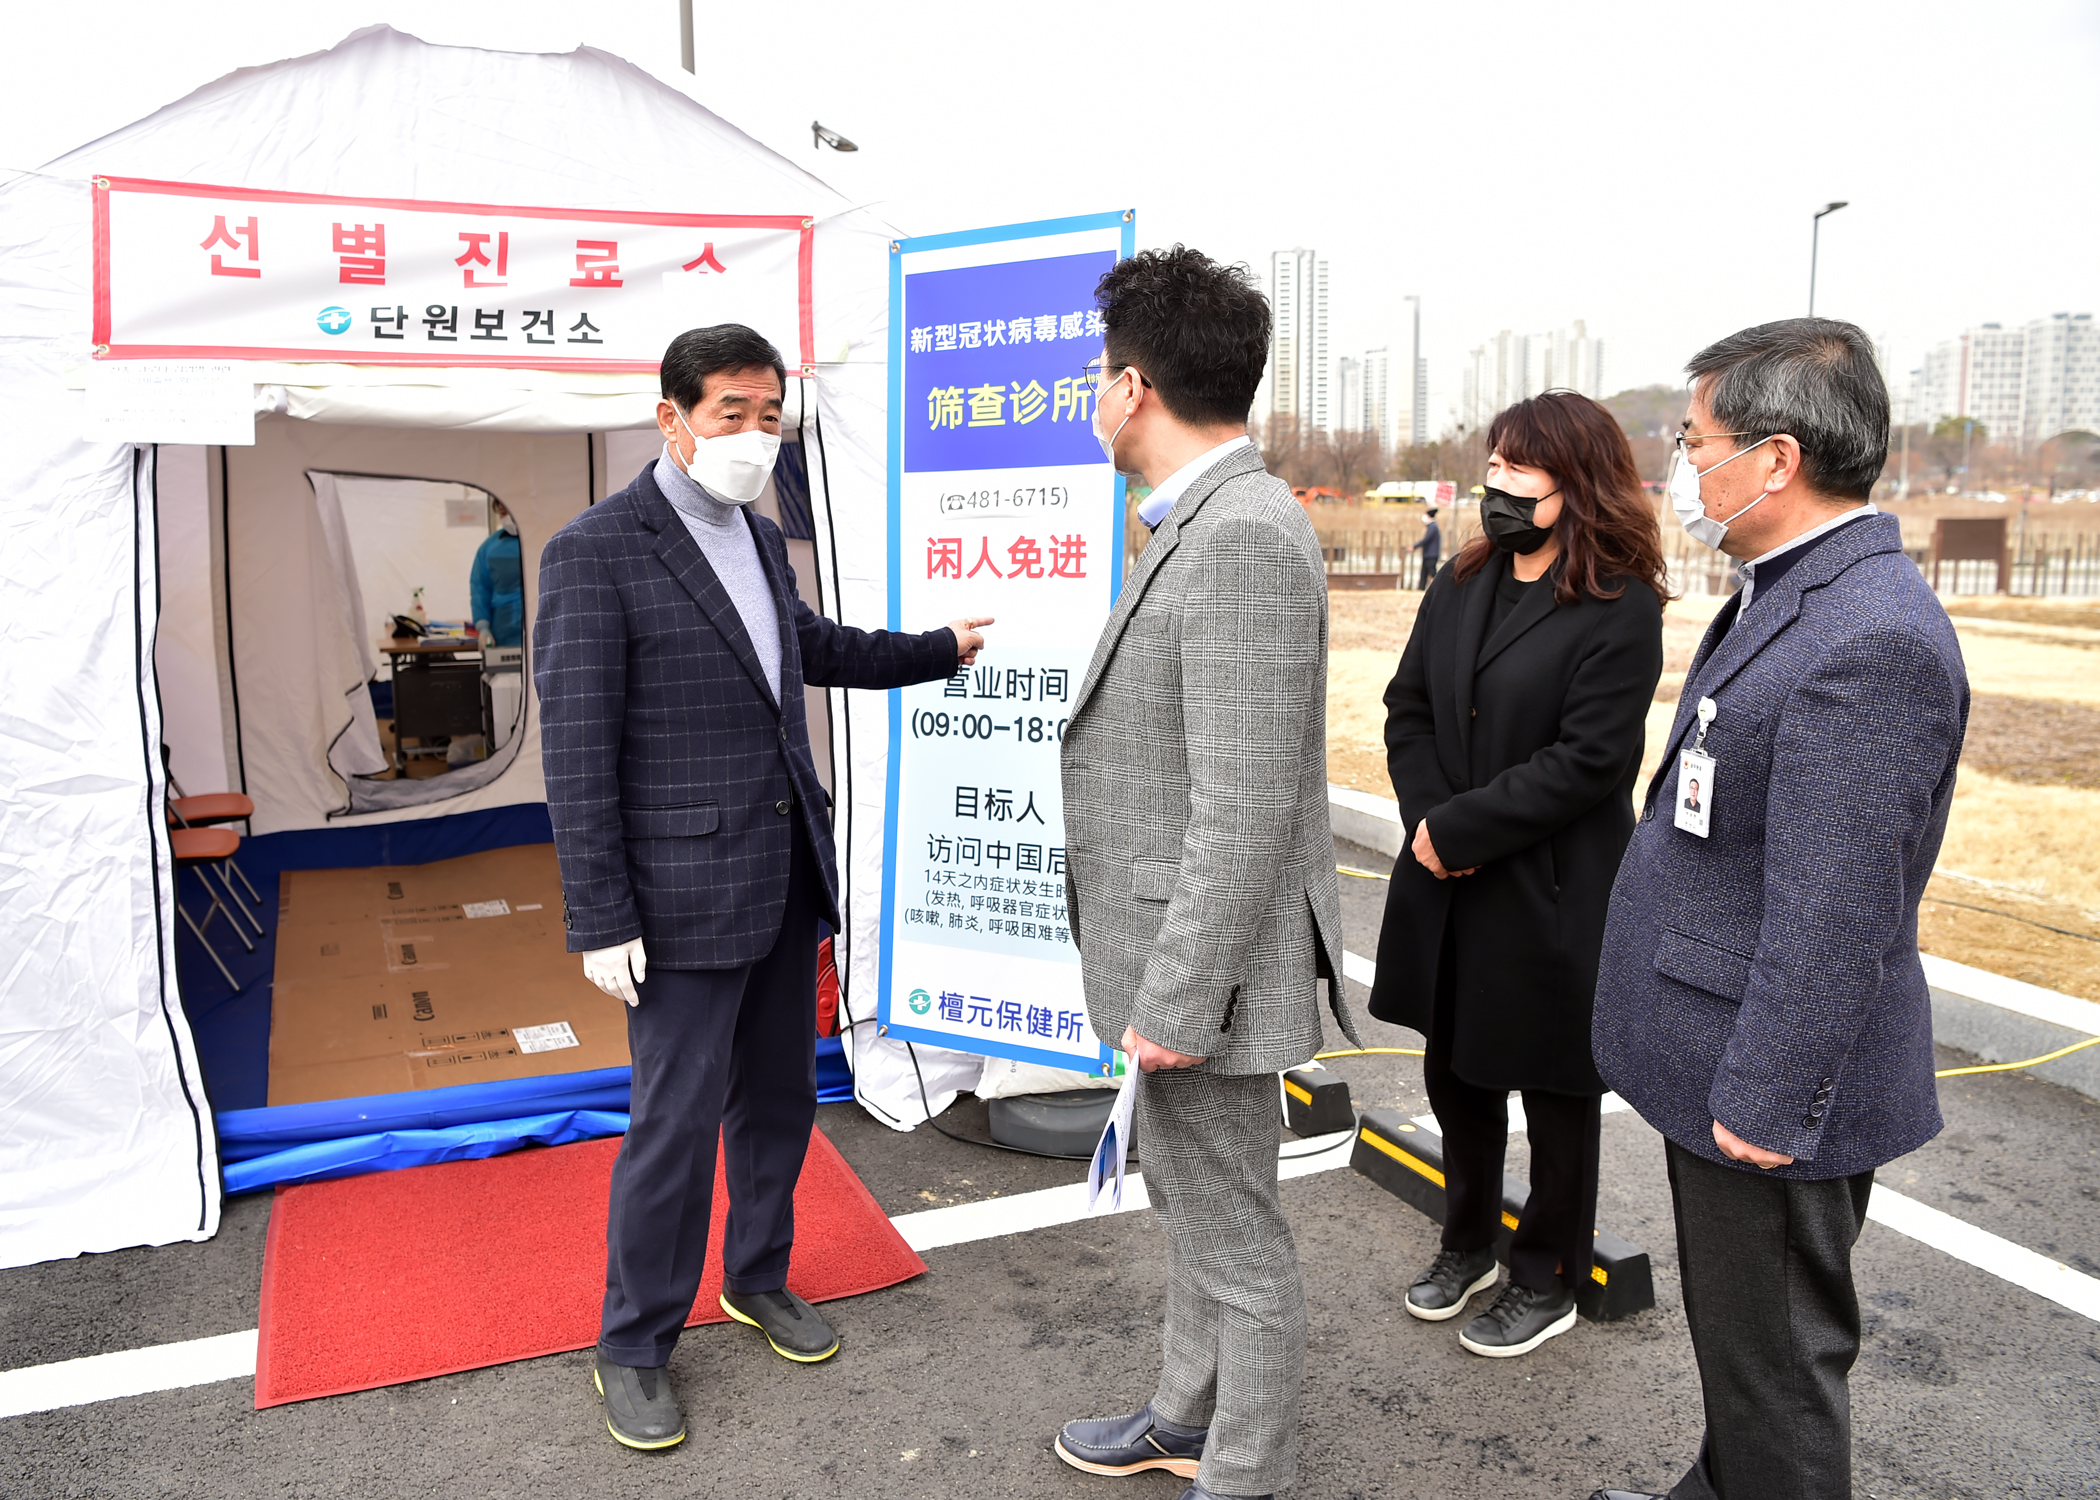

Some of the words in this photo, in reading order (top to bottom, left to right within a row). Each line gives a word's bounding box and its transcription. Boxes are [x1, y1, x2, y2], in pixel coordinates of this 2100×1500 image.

[369, 304, 605, 346] 단원보건소
[926, 376, 1092, 431] 筛查诊所
[926, 534, 1087, 580] 闲人免进
[943, 665, 1069, 703] 营业时间
[955, 786, 1046, 826] 目标人
[387, 882, 404, 900] Canon
[401, 944, 417, 964] Canon
[412, 991, 435, 1021] Canon
[938, 990, 1085, 1044] 檀元保健所
